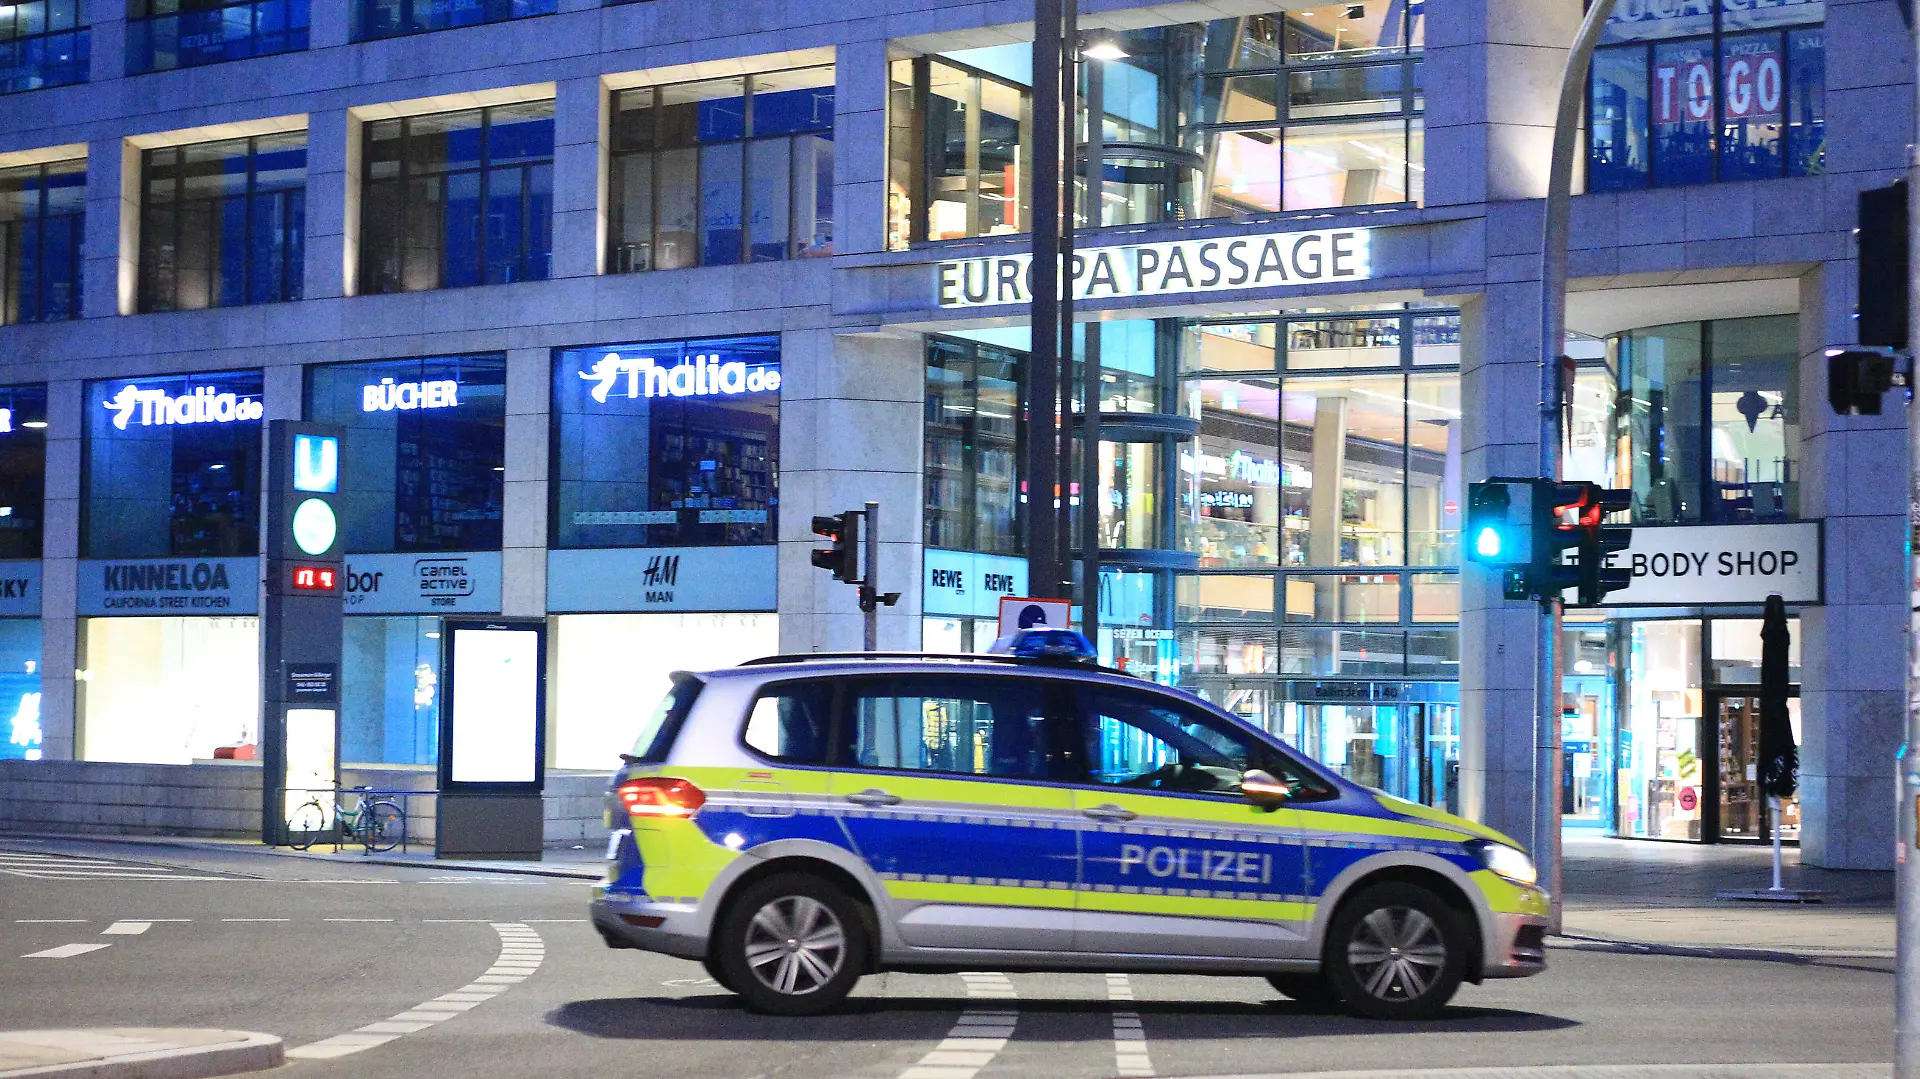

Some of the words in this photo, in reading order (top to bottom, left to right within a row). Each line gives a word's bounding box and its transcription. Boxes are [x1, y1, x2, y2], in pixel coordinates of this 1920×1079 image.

[1729, 43, 1773, 55] PIZZA
[940, 253, 1119, 304] EURPA
[1137, 233, 1356, 291] PASSAGE
[363, 377, 458, 412] BÜCHER
[299, 438, 334, 490] U
[420, 565, 468, 577] camel
[1632, 552, 1709, 577] BODY
[1717, 550, 1798, 576] SHOP
[104, 562, 230, 592] KINNELOA
[420, 578, 467, 590] active
[932, 569, 962, 588] REWE
[985, 573, 1013, 593] REWE
[158, 596, 189, 609] STREET
[191, 596, 231, 609] KITCHEN
[431, 597, 456, 607] STORE
[646, 591, 673, 603] MAN
[1119, 843, 1272, 884] POLIZEI
